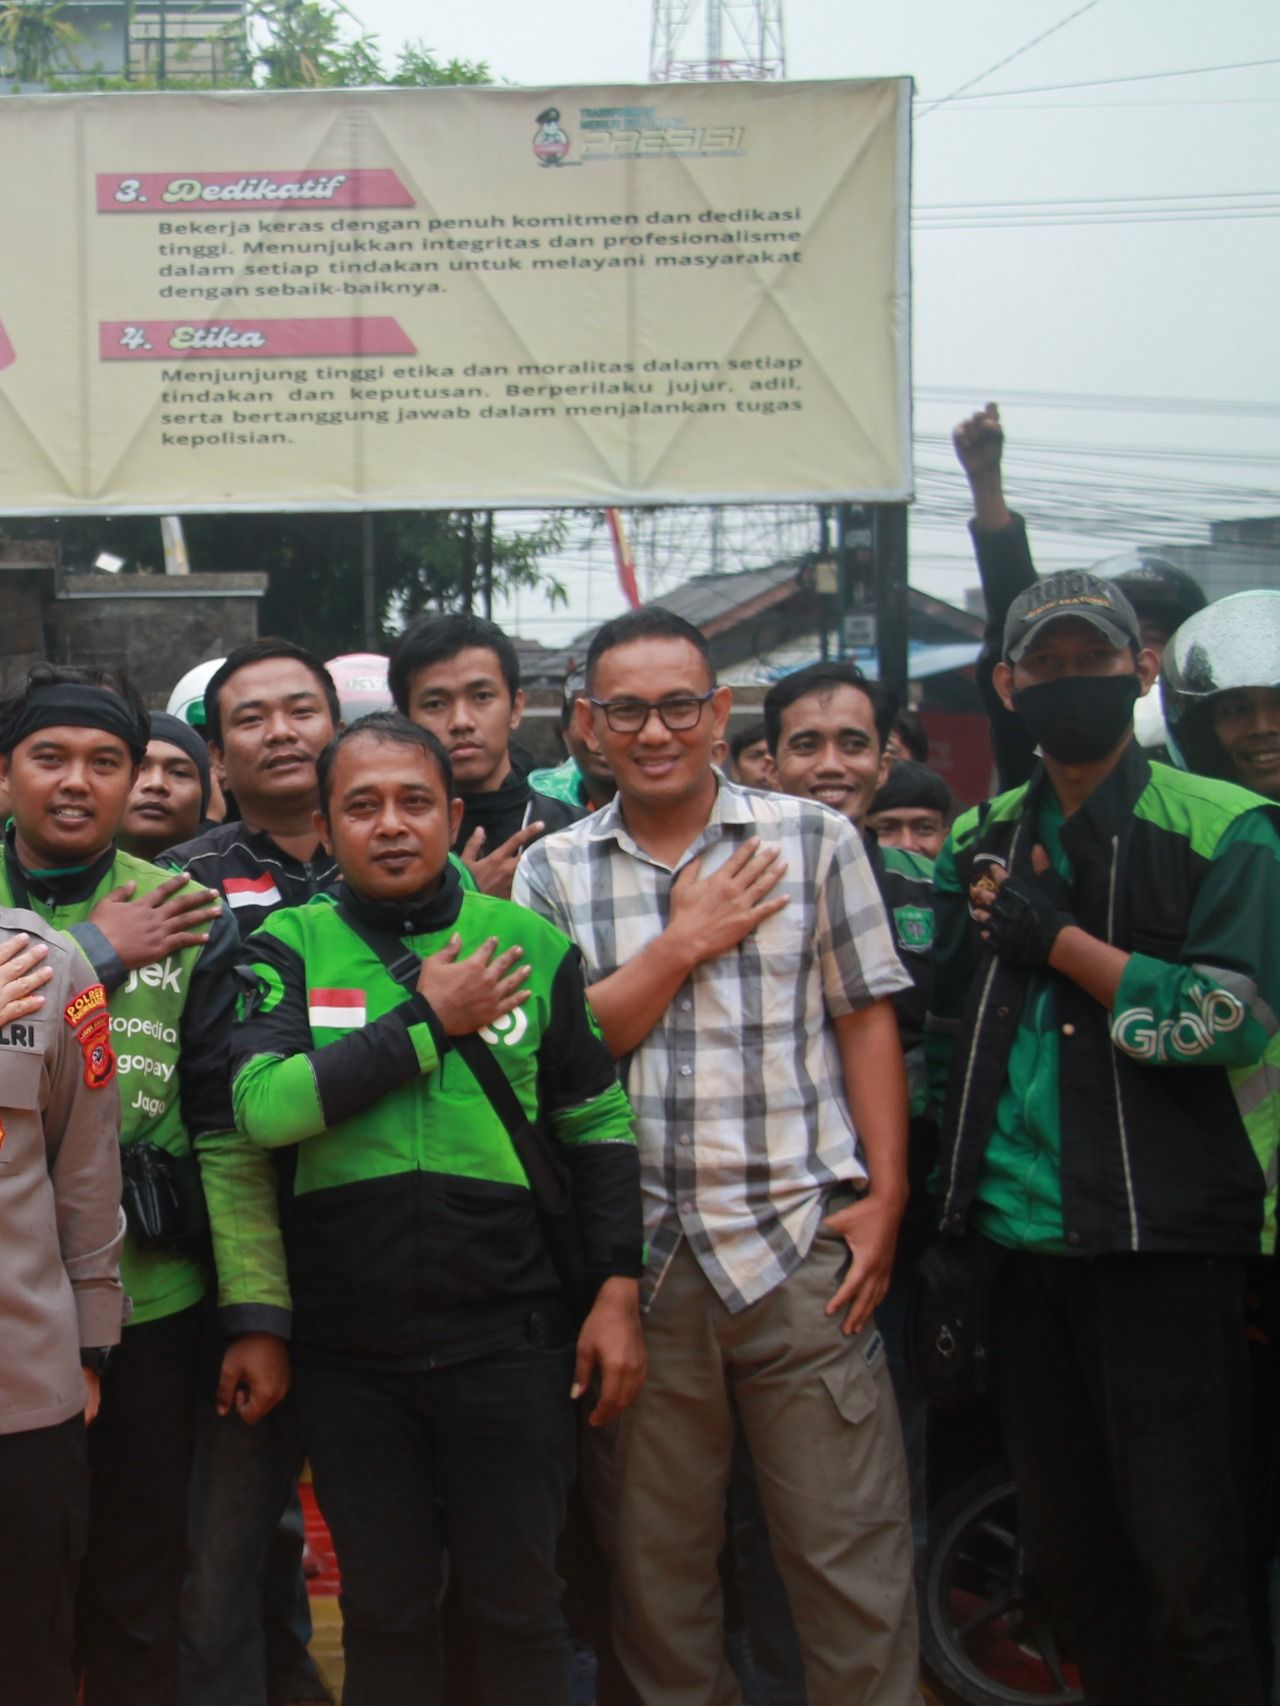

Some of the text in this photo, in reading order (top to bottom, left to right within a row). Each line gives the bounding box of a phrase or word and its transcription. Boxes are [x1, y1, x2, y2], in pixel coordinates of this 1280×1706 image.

[114, 176, 345, 203] 3. Dedikatif
[158, 207, 801, 237] Bekerja keras dengan penuh komitmen dan dedikasi
[158, 230, 801, 259] tinggi. Menunjukkan integritas dan profesionalisme
[158, 250, 802, 278] dalam setiap tindakan untuk melayani masyarakat
[159, 281, 446, 301] dengan sebaik-baiknya.
[120, 327, 264, 351] 4. Etika
[161, 356, 802, 385] Menjunjung tinggi etika dan moralitas dalam setiap
[161, 389, 273, 404] tindakan
[288, 388, 334, 402] dan
[350, 387, 489, 403] keputusan.
[506, 381, 653, 399] Berperilaku
[161, 400, 802, 426] serta bertanggung jawab dalam menjalankan tugas
[162, 431, 293, 449] kepolisian.
[1110, 984, 1245, 1061] Grab
[117, 1054, 176, 1083] gopay
[131, 1089, 166, 1118] Jago
